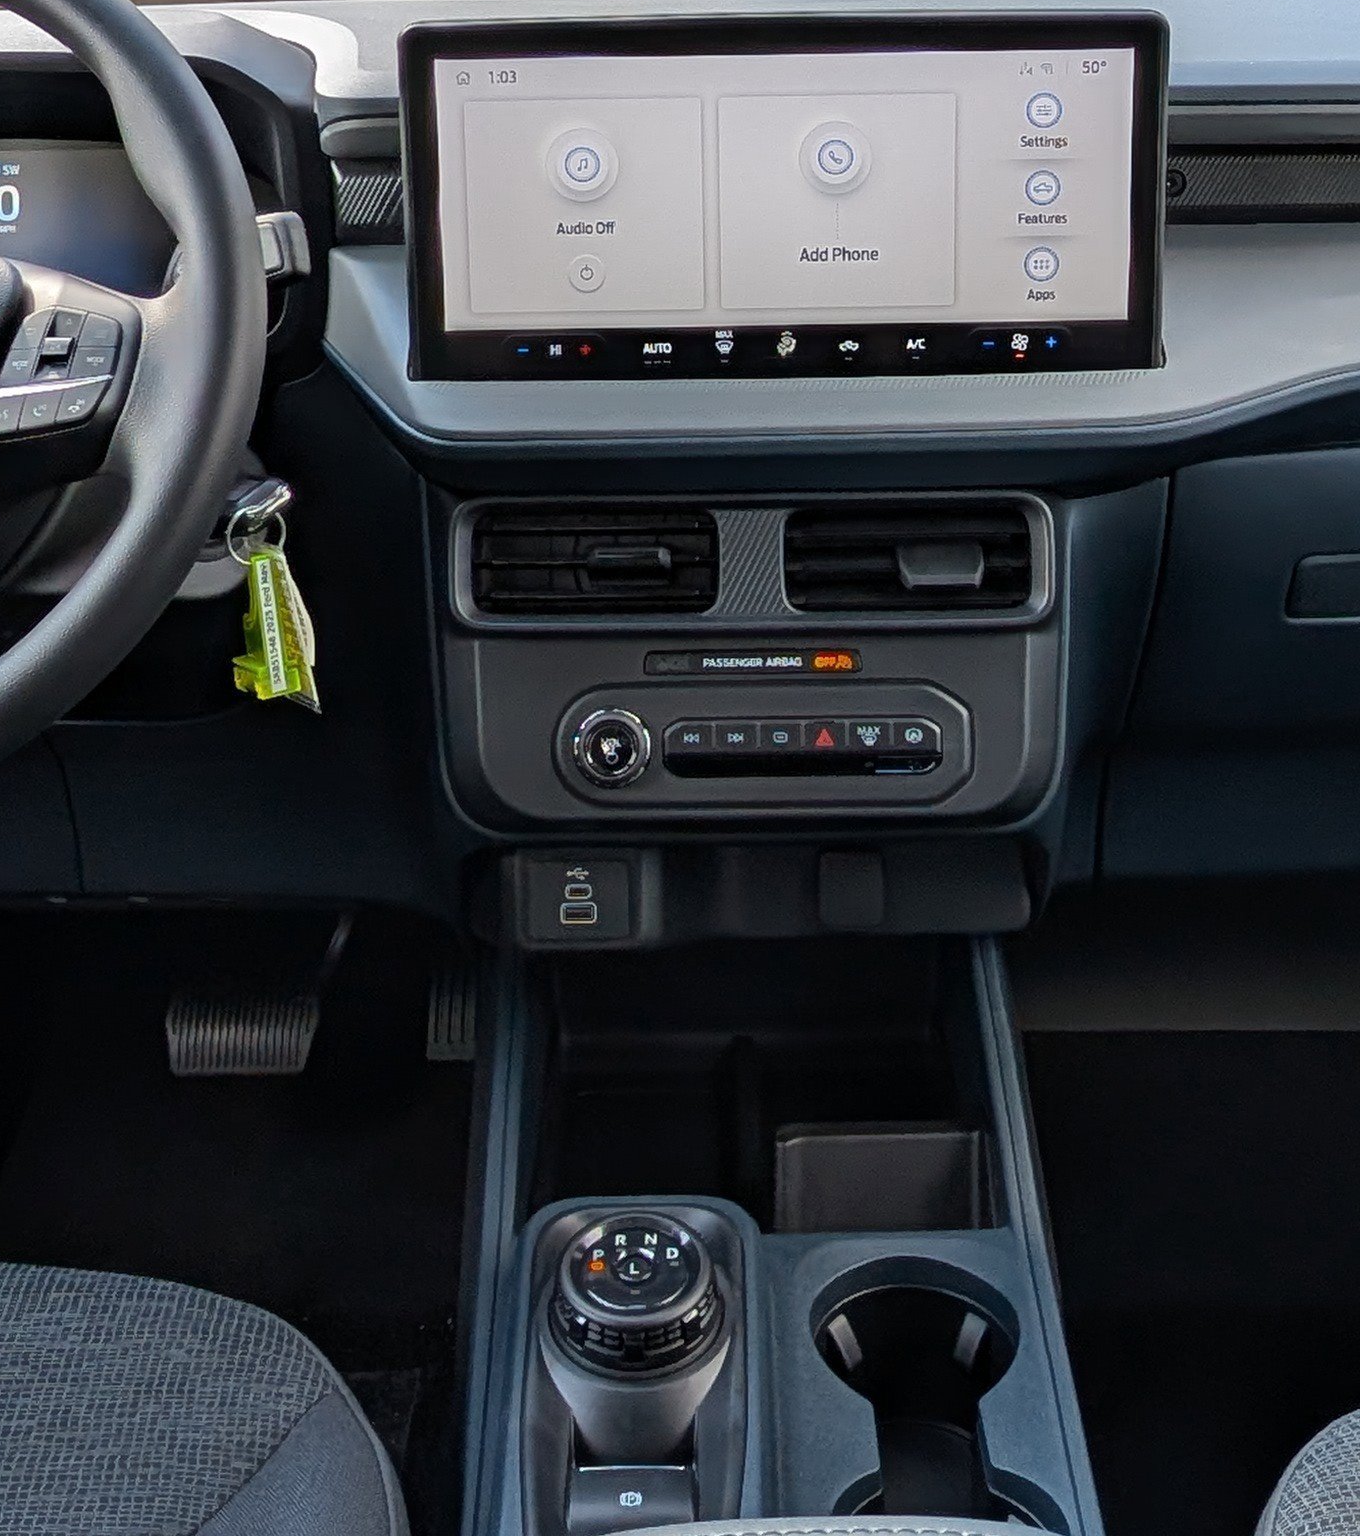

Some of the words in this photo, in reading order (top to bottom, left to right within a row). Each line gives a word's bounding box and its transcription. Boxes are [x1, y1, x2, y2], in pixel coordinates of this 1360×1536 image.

[1081, 60, 1107, 75] 50°
[488, 70, 517, 85] 1:03
[1019, 135, 1069, 149] Settings
[1017, 212, 1068, 225] Features
[556, 221, 594, 235] Audio
[595, 221, 616, 235] Off
[799, 247, 829, 262] Add
[831, 247, 879, 262] Phone
[1026, 288, 1056, 302] Apps
[549, 343, 563, 357] HI
[642, 341, 673, 355] AUTO
[906, 338, 927, 351] A/C
[702, 657, 764, 669] PASSENGER
[765, 656, 803, 668] AIRBAG
[856, 725, 882, 736] MAX
[615, 1234, 628, 1246] R
[645, 1233, 658, 1245] N
[593, 1249, 605, 1261] P
[666, 1248, 679, 1260] D
[630, 1263, 640, 1275] L
